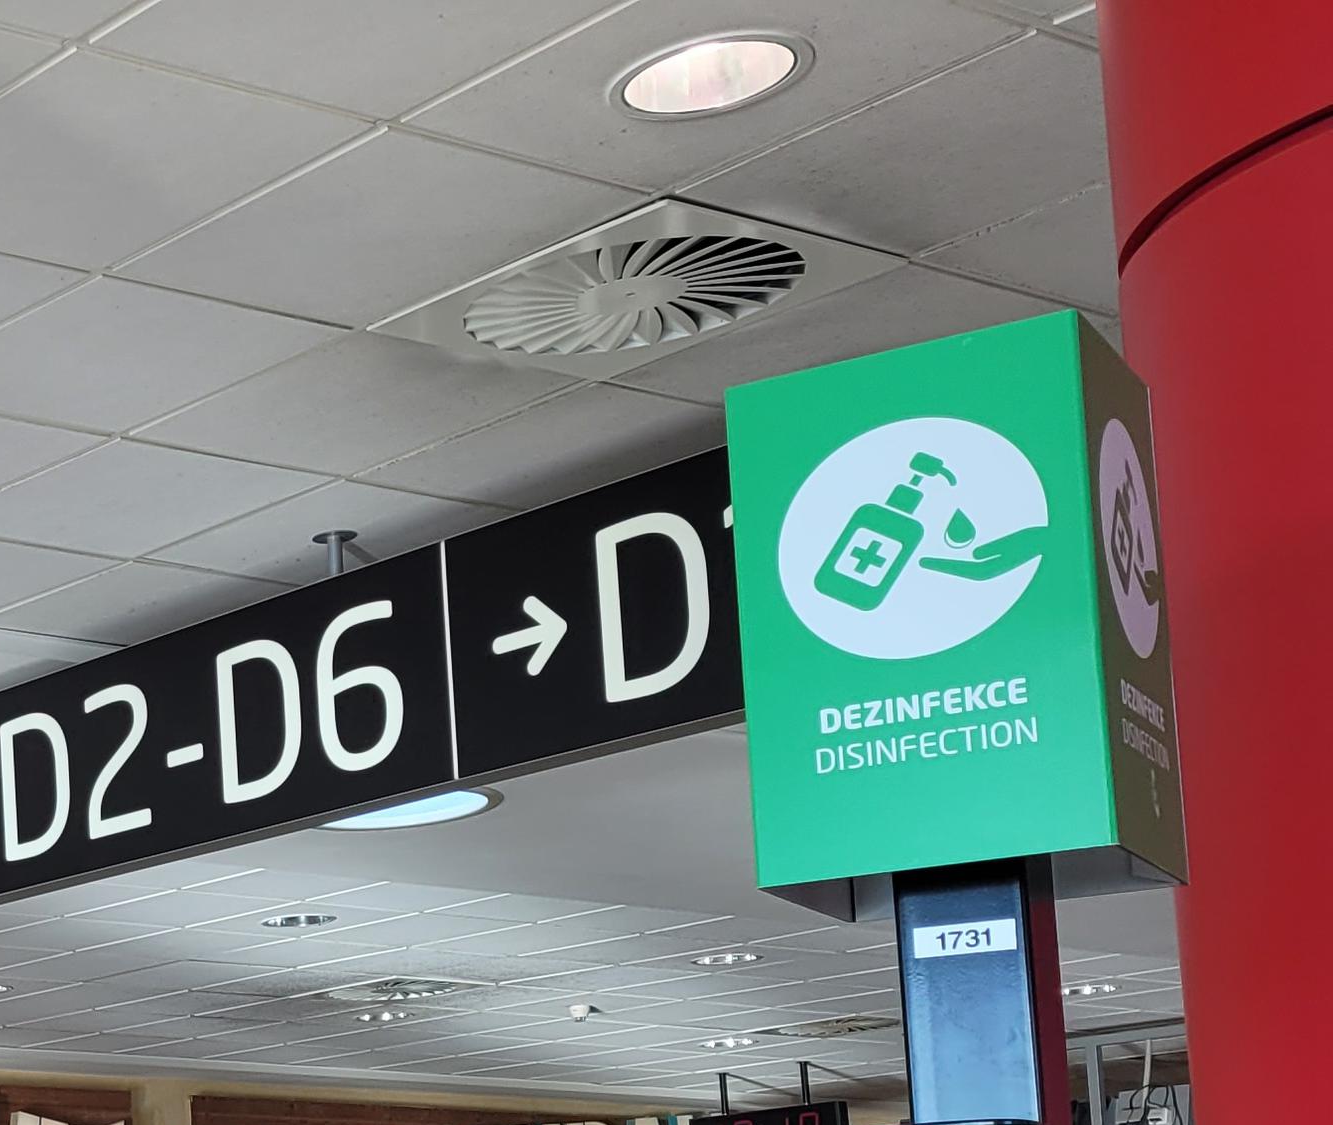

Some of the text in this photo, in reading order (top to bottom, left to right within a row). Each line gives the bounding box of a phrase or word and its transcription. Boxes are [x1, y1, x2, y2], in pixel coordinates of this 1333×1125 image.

[595, 504, 735, 704] D
[820, 677, 1028, 735] DEZINFEKCE
[815, 717, 1038, 775] DISINFECTION
[935, 928, 993, 951] 1731
